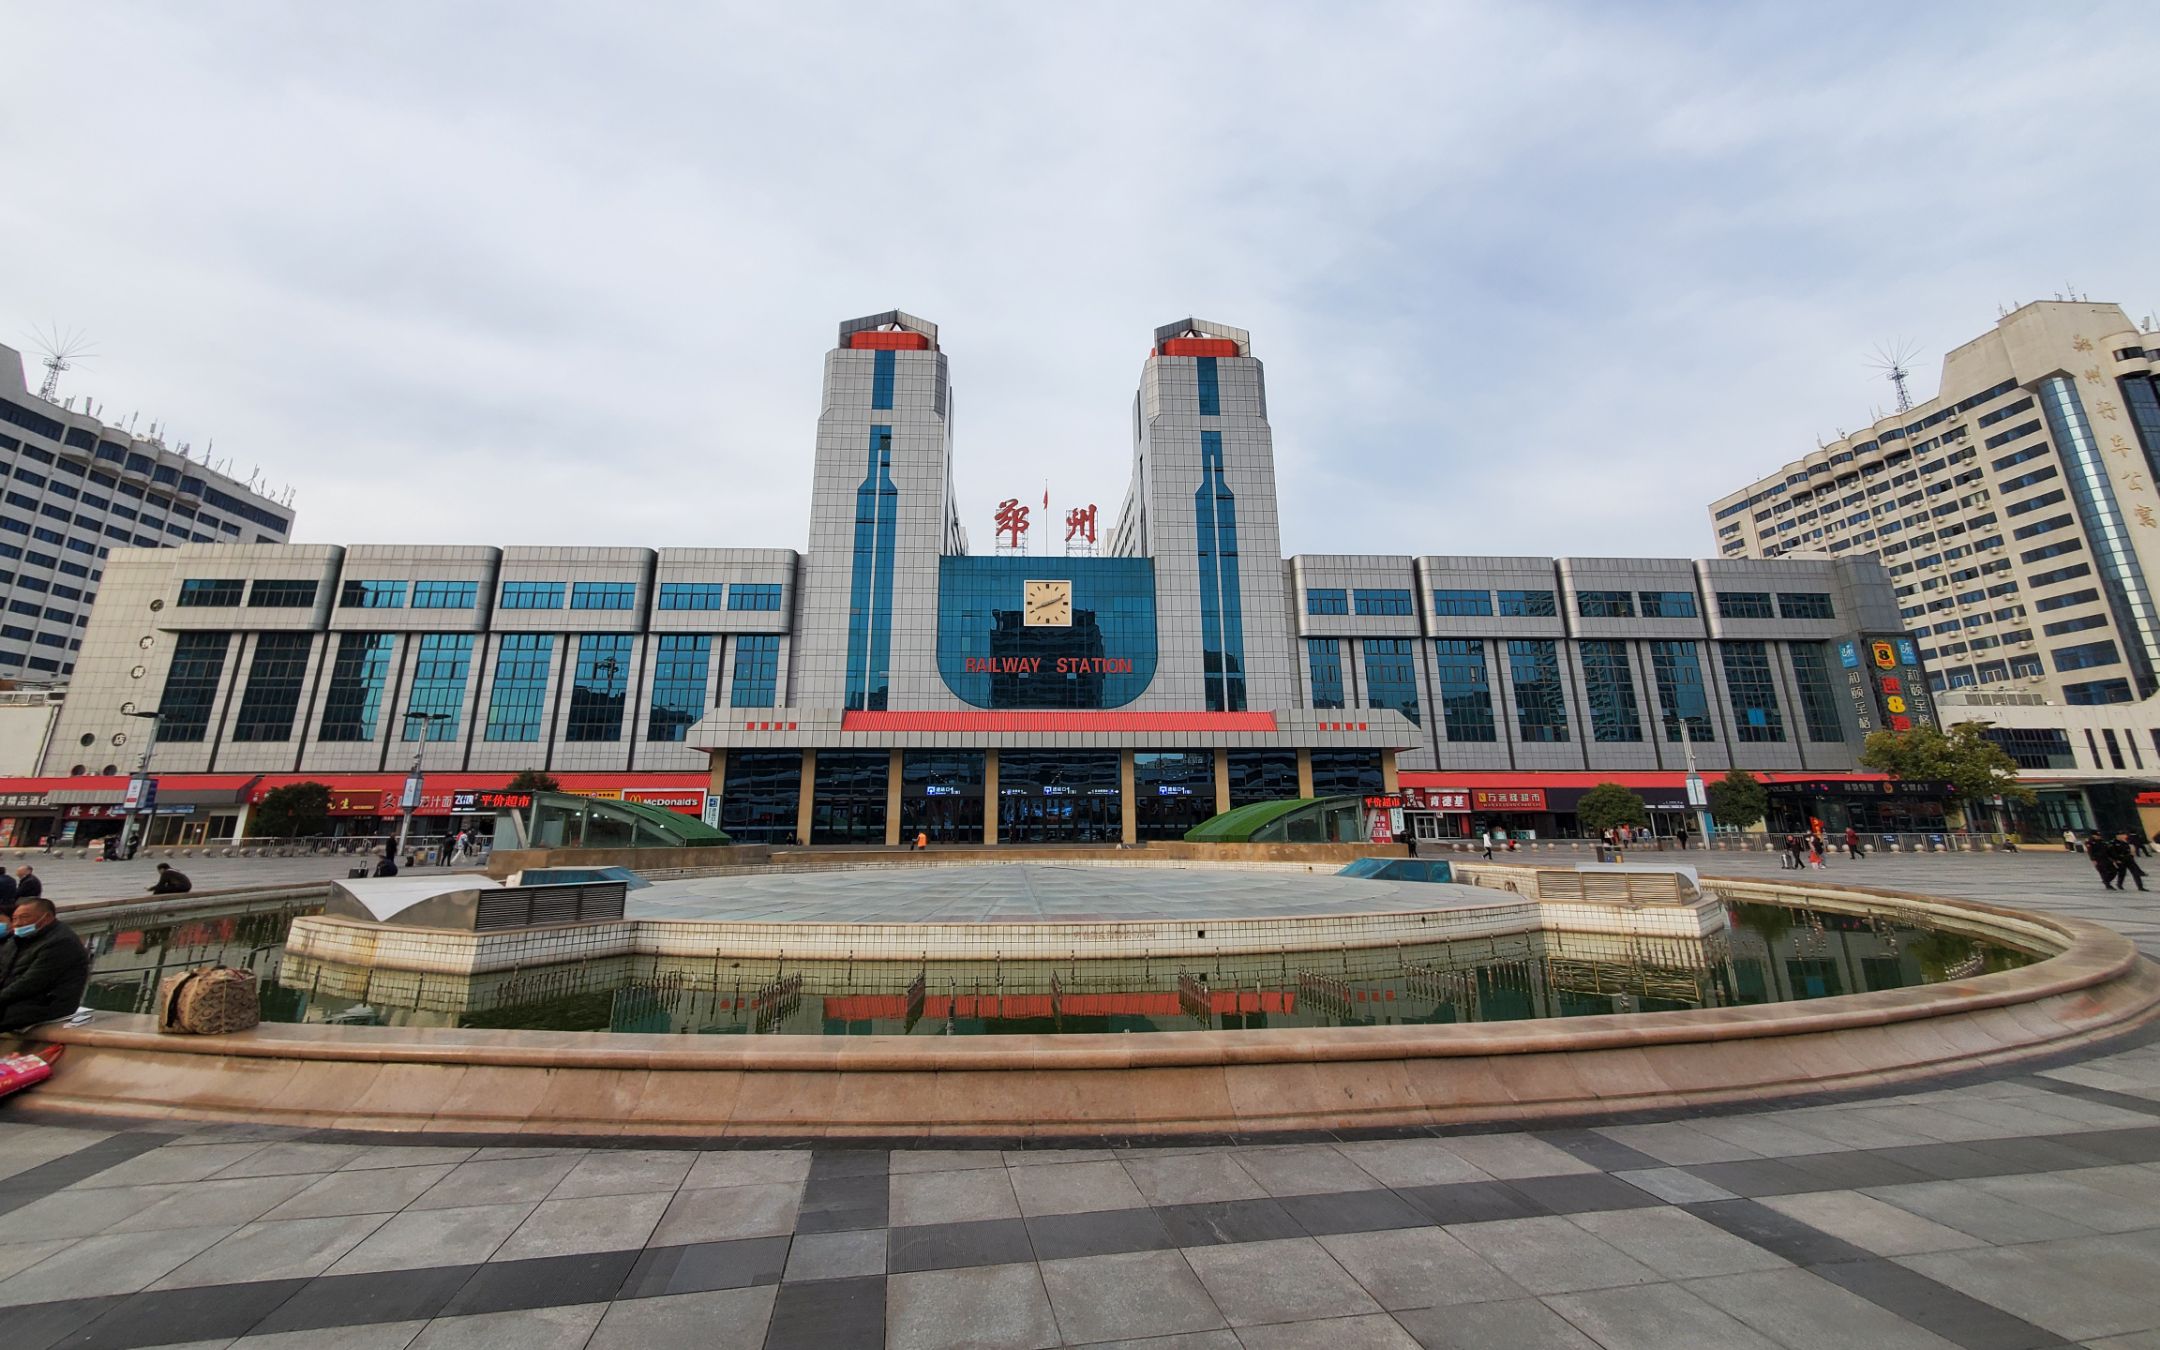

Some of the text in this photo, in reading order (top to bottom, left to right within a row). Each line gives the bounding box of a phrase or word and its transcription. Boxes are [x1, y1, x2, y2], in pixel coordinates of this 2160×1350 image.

[994, 498, 1097, 548] 郑州
[965, 657, 1132, 673] RAILWAY STATION
[1847, 671, 1872, 737] 和颐至格
[1880, 676, 1912, 736] 速8酒
[1901, 783, 1929, 791] SWAT
[481, 794, 531, 808] 平价超市
[643, 798, 698, 806] McDonald's
[1430, 795, 1464, 807] 肯德基
